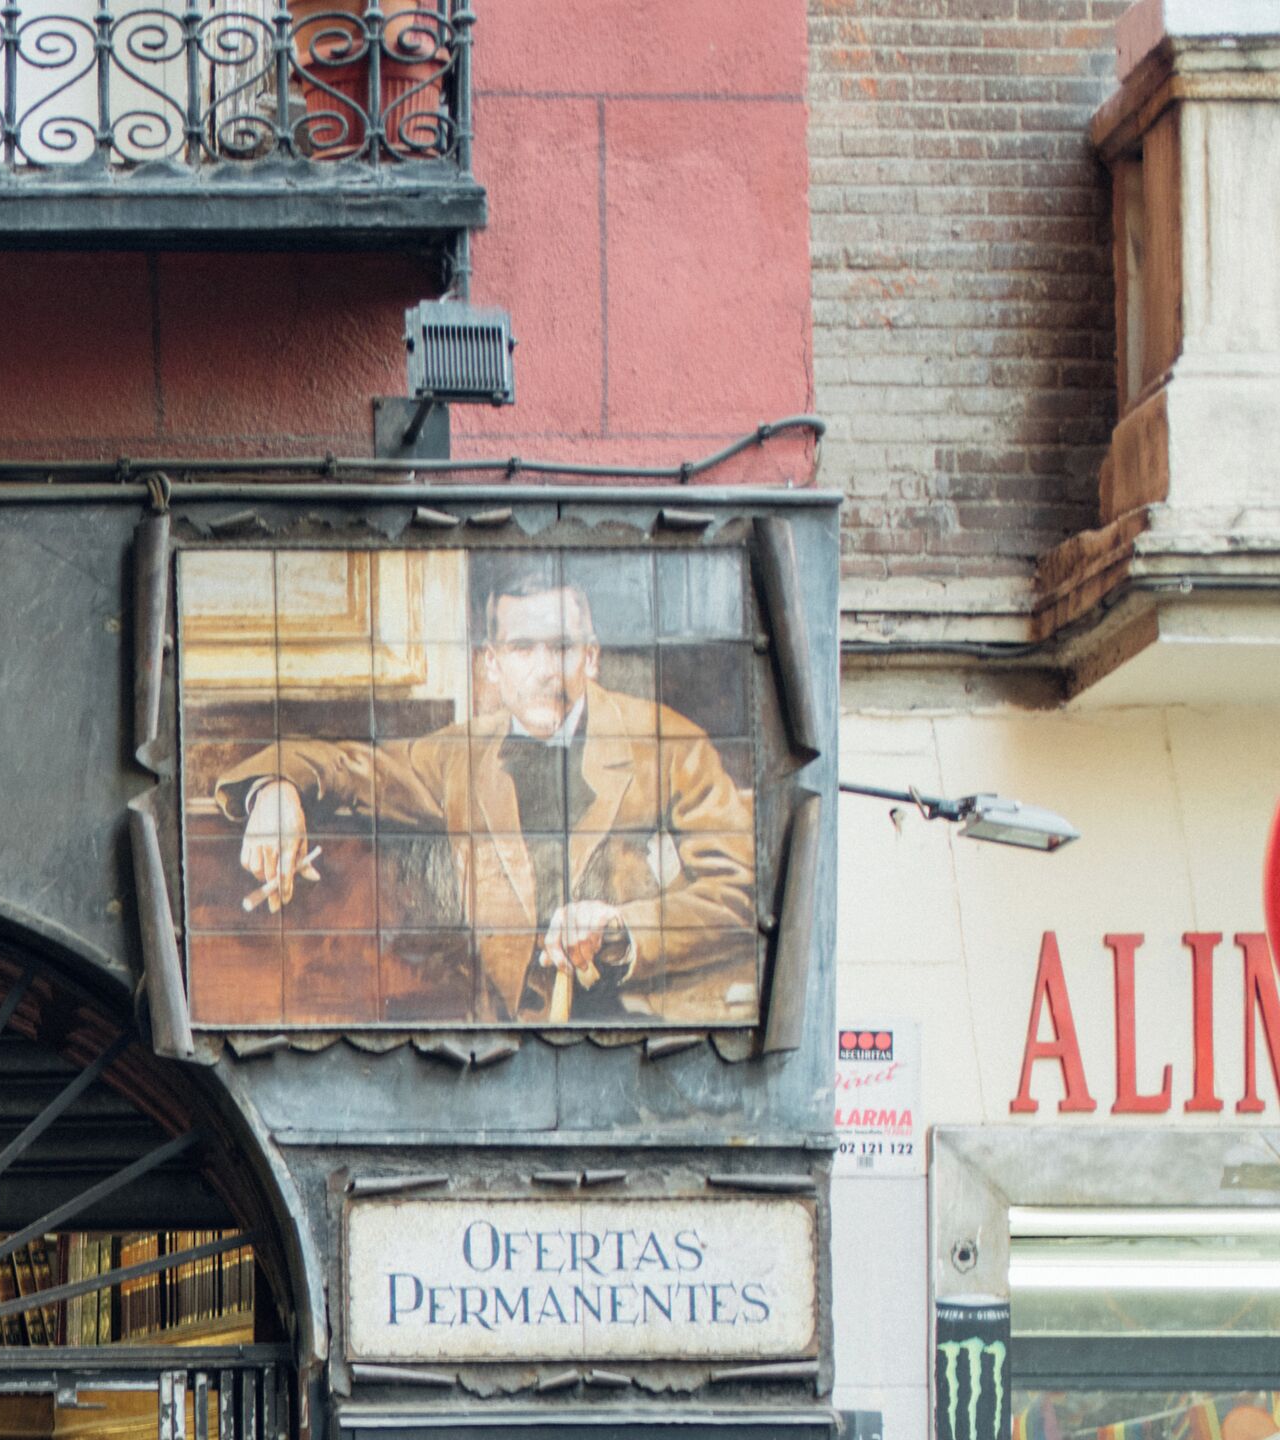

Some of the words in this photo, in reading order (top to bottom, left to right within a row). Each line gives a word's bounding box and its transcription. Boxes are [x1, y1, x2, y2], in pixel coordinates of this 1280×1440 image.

[861, 1143, 883, 1154] 121
[890, 1143, 913, 1154] 122
[462, 1219, 704, 1277] OFERTAS
[387, 1272, 772, 1330] PERMANENTES
